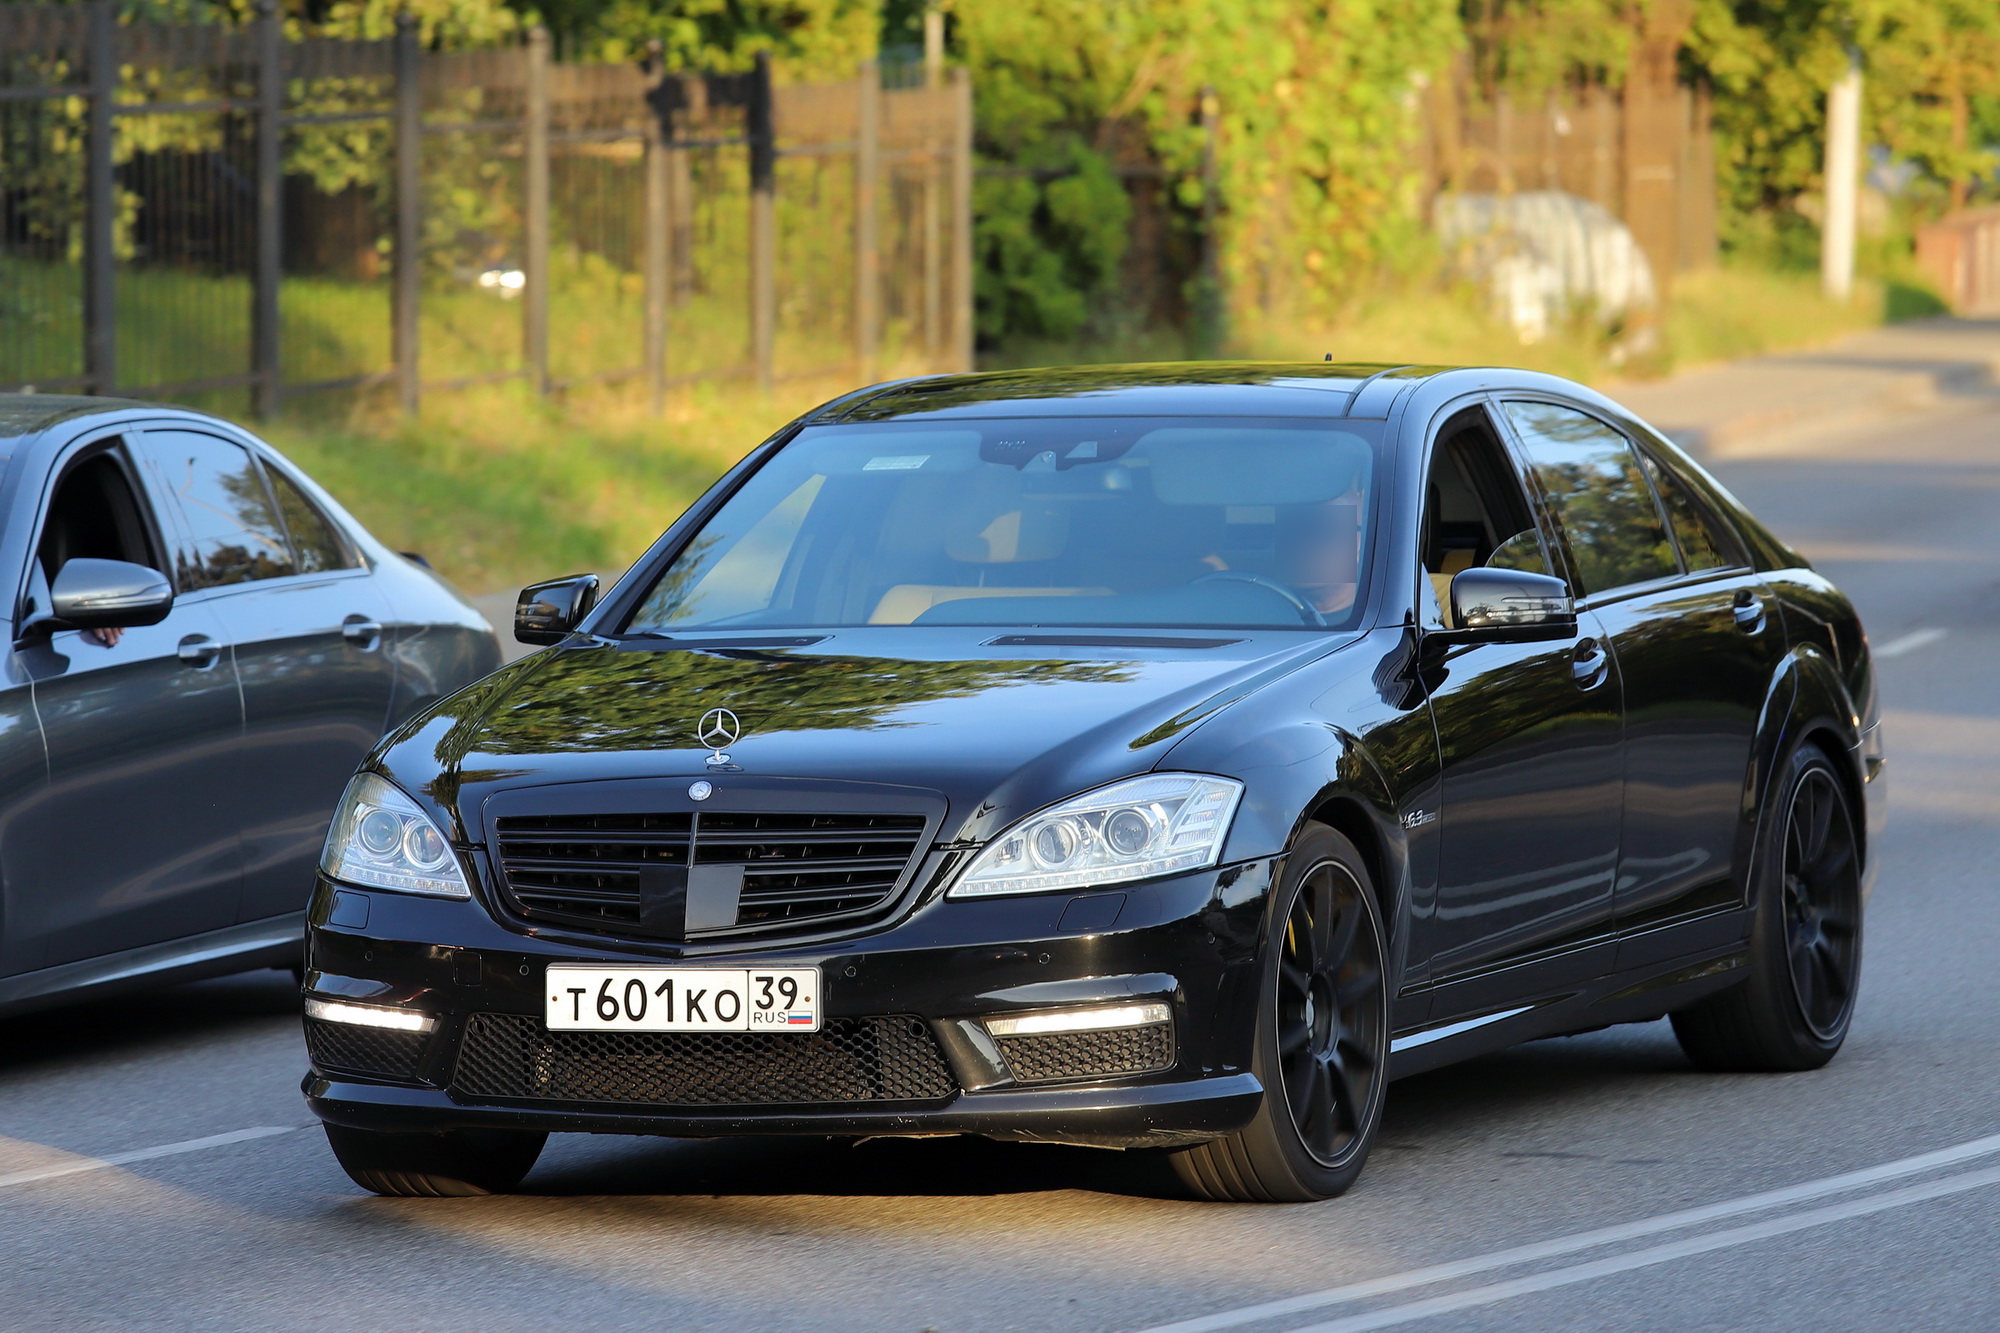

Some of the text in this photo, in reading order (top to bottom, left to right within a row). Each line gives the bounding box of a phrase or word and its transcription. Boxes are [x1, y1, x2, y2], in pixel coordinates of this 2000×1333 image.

[566, 976, 798, 1023] T601KO 39
[753, 1011, 787, 1024] RUS
